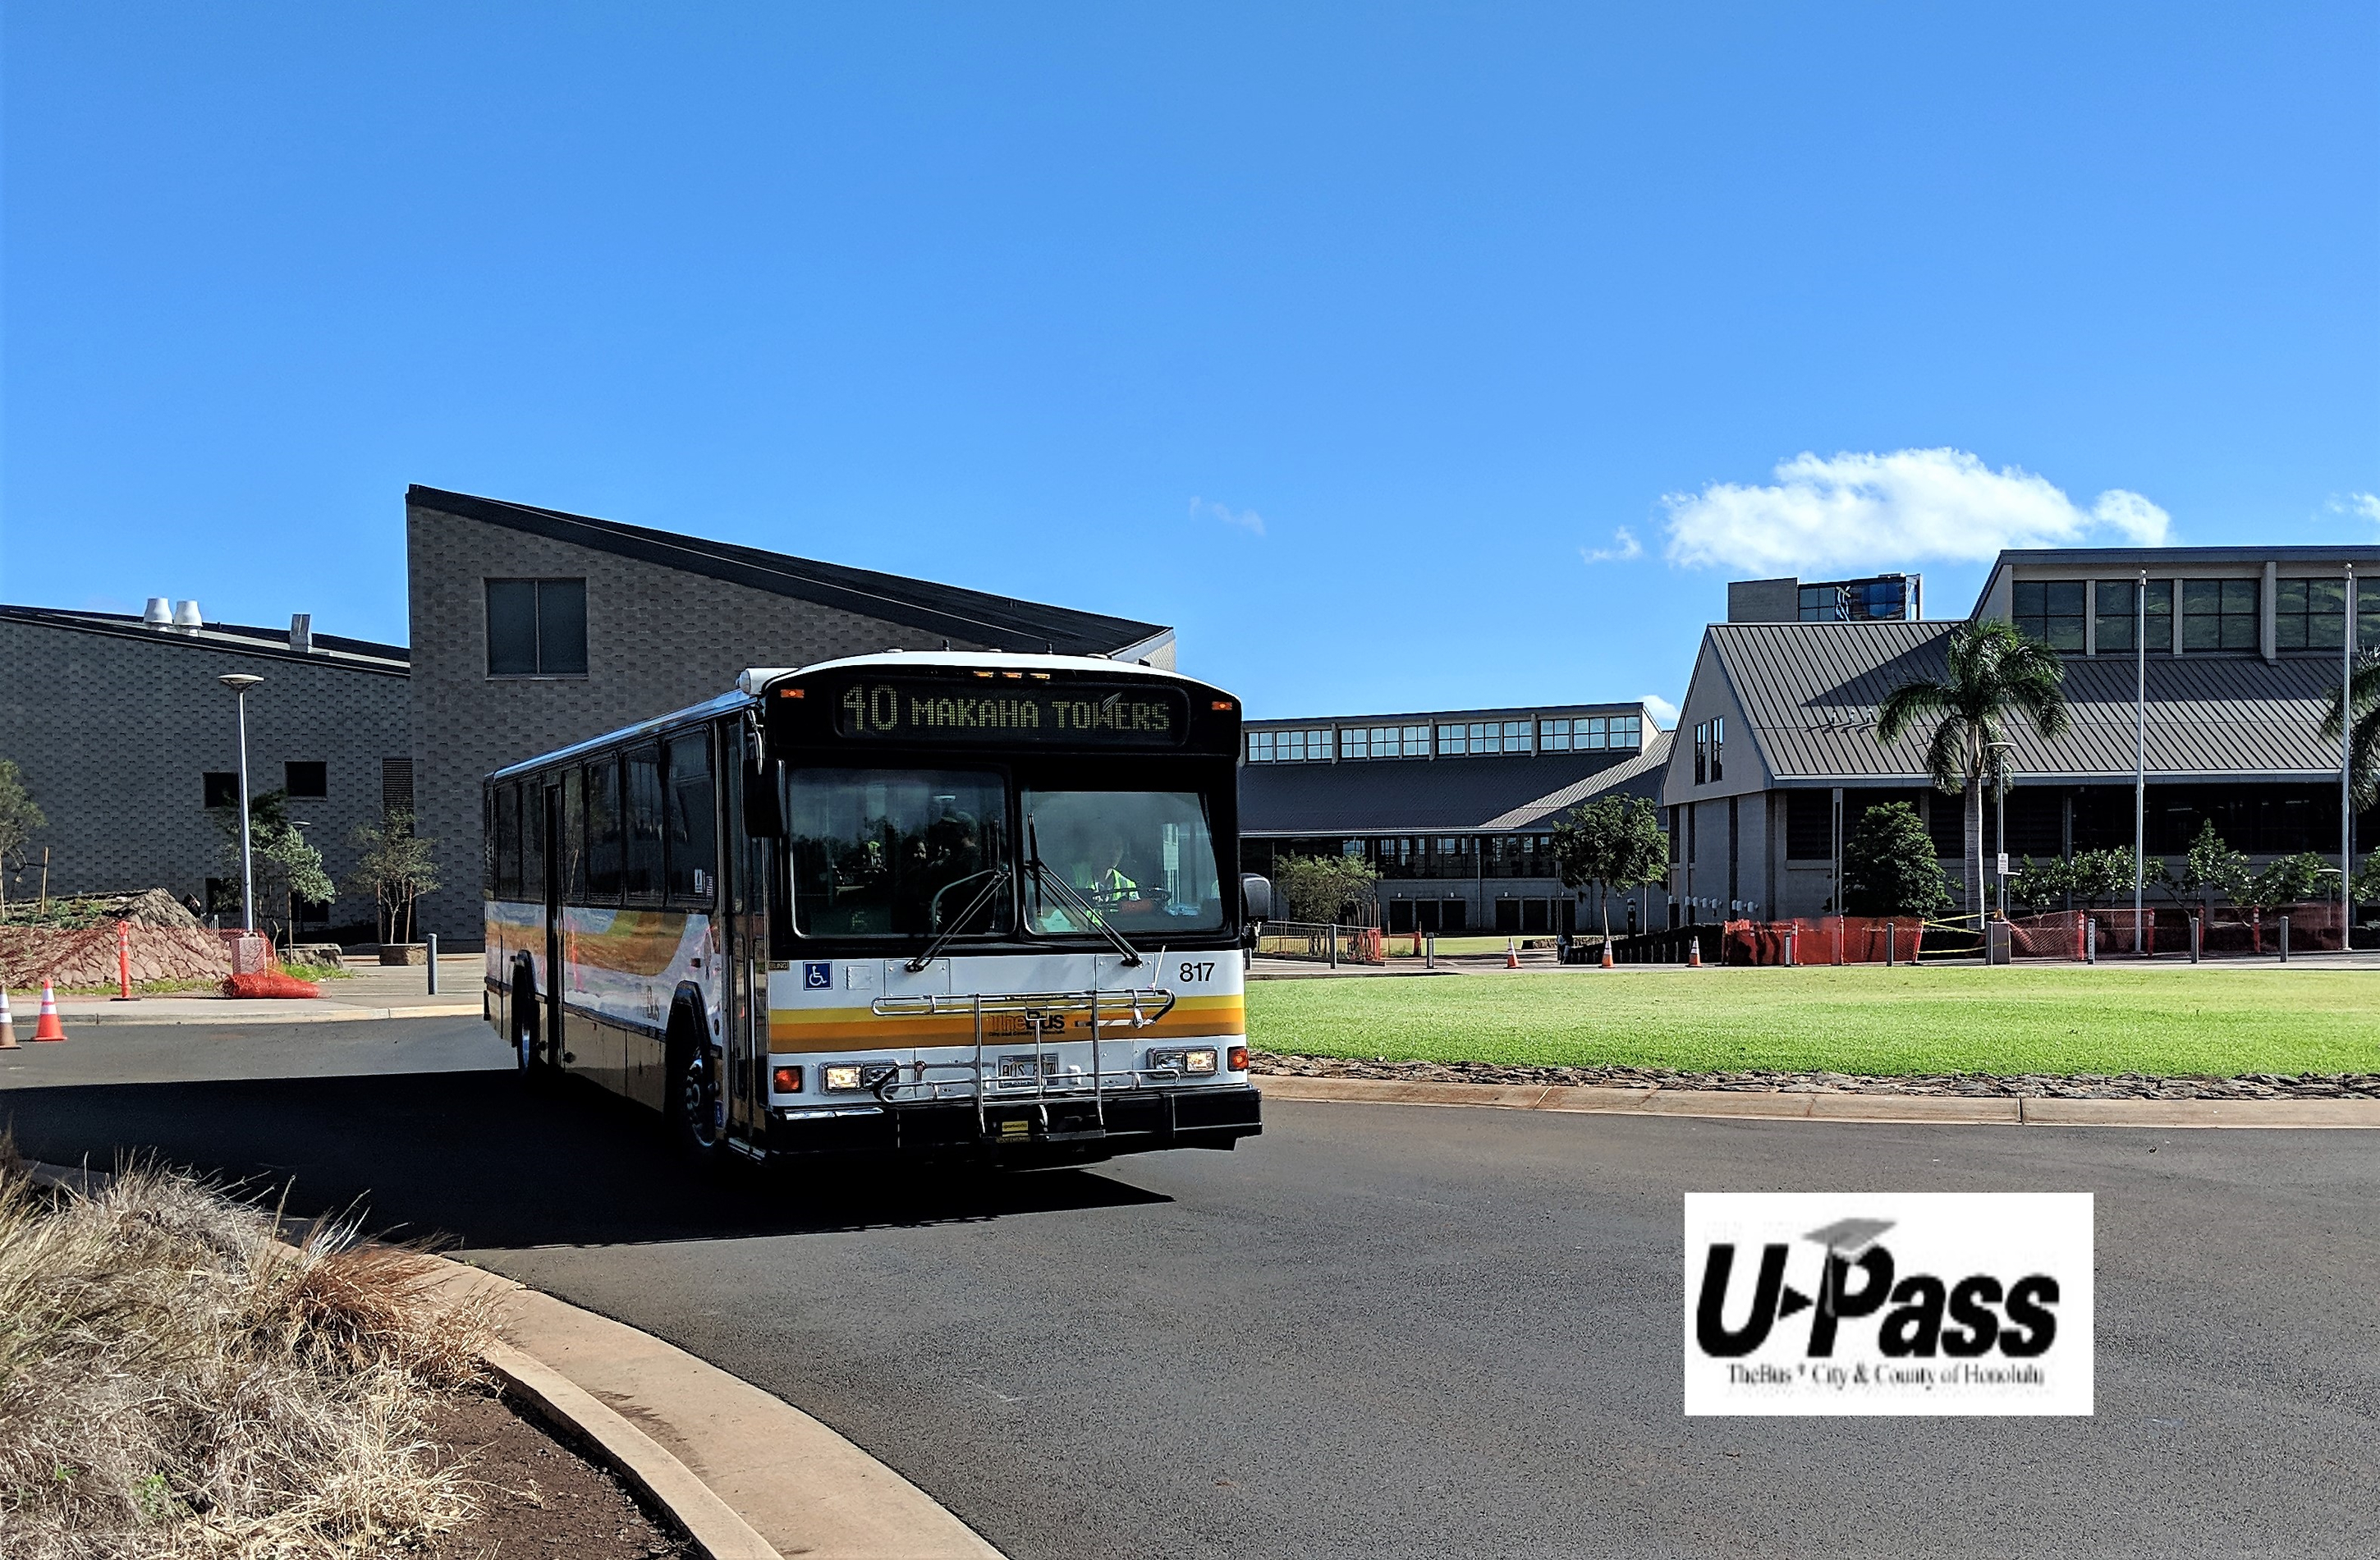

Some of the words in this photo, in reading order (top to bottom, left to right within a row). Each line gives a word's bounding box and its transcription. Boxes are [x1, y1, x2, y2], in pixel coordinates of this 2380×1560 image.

[844, 684, 897, 731] 40
[911, 697, 1039, 727] MAKAHA
[1052, 700, 1170, 730] TOWERS
[1179, 962, 1215, 982] 817
